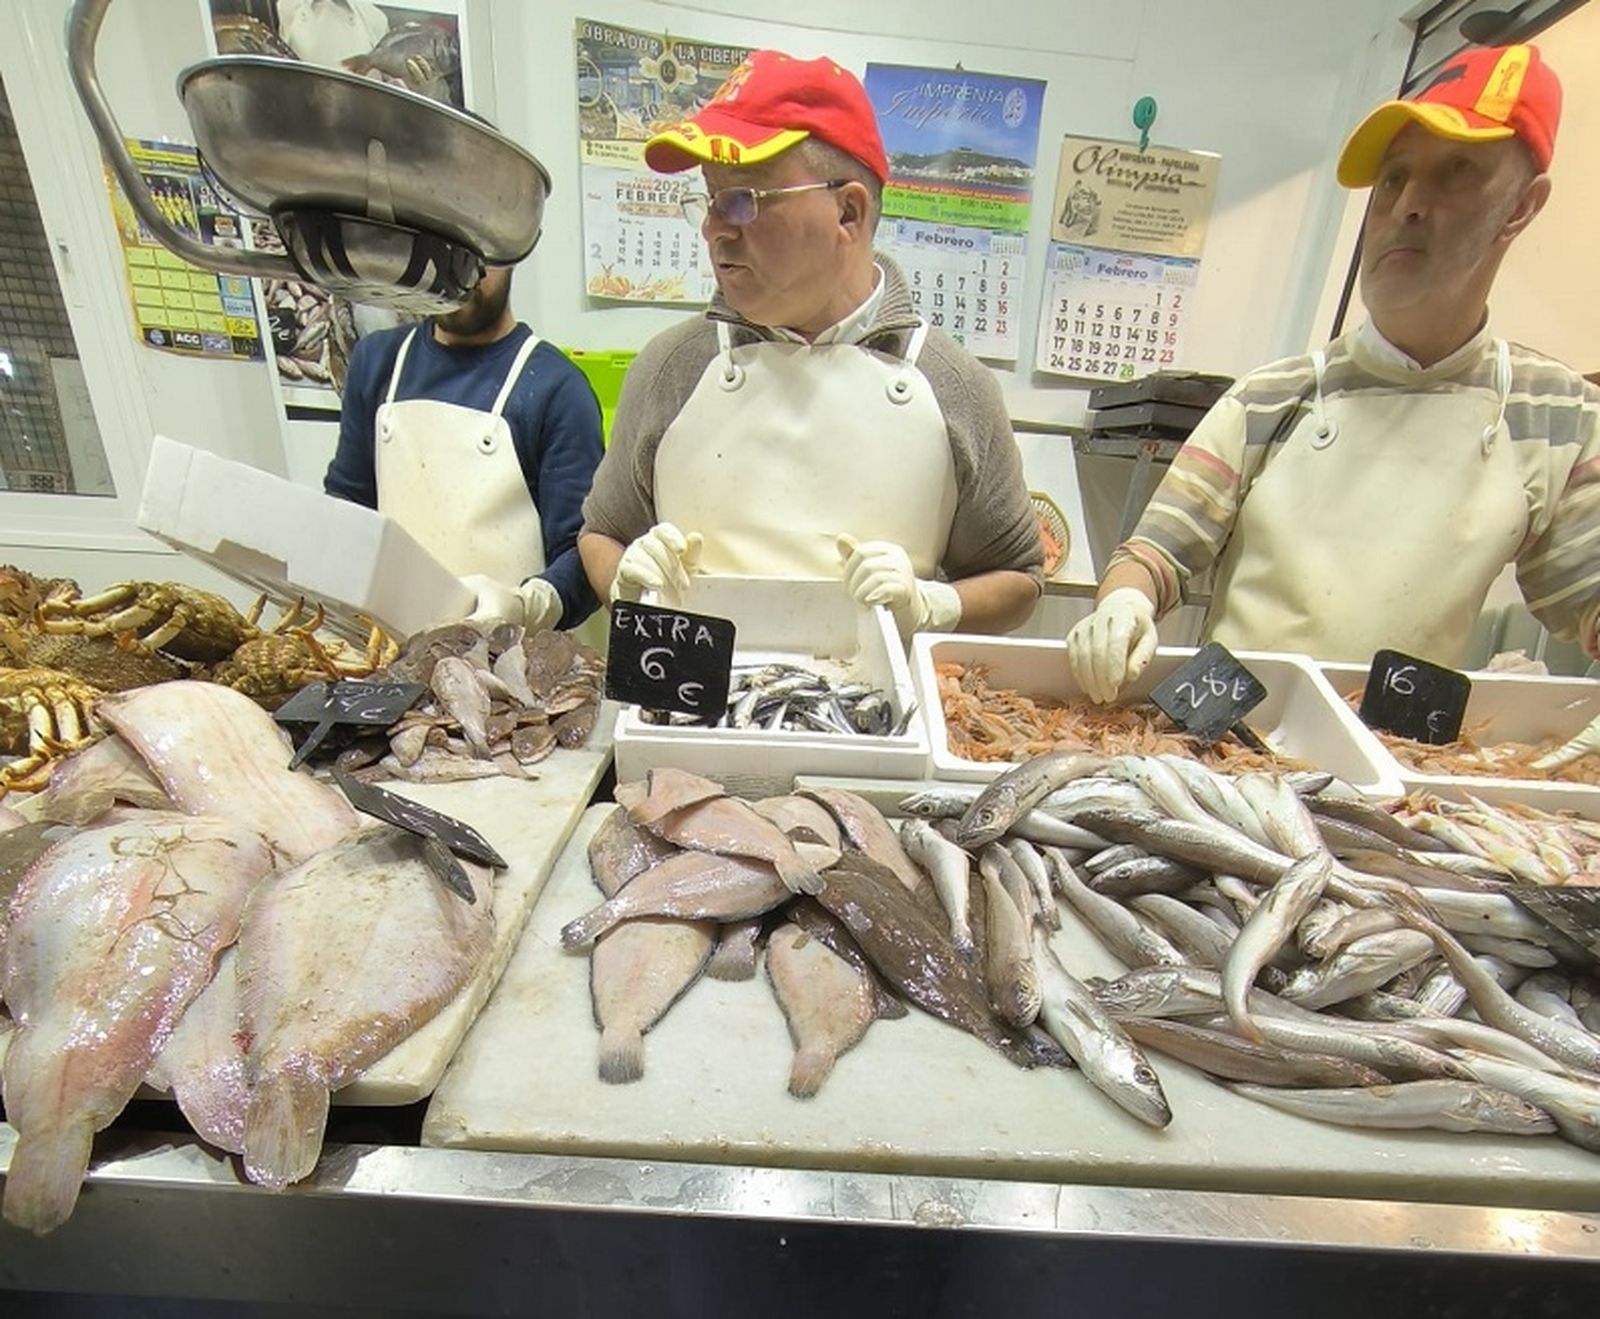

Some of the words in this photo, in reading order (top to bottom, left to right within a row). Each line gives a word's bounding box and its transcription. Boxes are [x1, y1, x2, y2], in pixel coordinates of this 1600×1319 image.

[582, 23, 660, 55] OBRADOR
[677, 44, 697, 61] LA
[700, 48, 748, 65] CIBELE
[920, 82, 1005, 103] IMPRENTA
[1073, 146, 1206, 191] Olimpia
[616, 188, 679, 204] FEBRER
[915, 231, 974, 249] Febrero
[982, 259, 987, 274] 1
[1002, 261, 1009, 276] 2
[1097, 263, 1148, 279] Febrero
[914, 271, 921, 285] 5
[936, 274, 944, 288] 6
[958, 277, 966, 290] 7
[978, 279, 987, 293] 8
[1000, 281, 1008, 295] 9
[912, 291, 922, 304] 12
[934, 293, 944, 307] 13
[955, 296, 966, 310] 14
[976, 298, 987, 312] 15
[998, 300, 1008, 314] 16
[1156, 293, 1162, 306] 1
[1172, 295, 1182, 308] 2
[932, 312, 944, 326] 20
[954, 315, 964, 328] 21
[974, 318, 988, 332] 22
[996, 320, 1006, 334] 23
[1060, 299, 1068, 313] 3
[1078, 303, 1087, 316] 4
[1096, 305, 1104, 318] 5
[1114, 307, 1122, 320] 6
[1132, 309, 1142, 323] 7
[1151, 311, 1160, 325] 8
[1169, 313, 1178, 327] 9
[1056, 318, 1068, 332] 10
[1074, 320, 1085, 335] 11
[1092, 323, 1104, 337] 12
[1110, 325, 1121, 339] 13
[1127, 328, 1140, 342] 14
[1146, 330, 1158, 344] 15
[1164, 332, 1176, 346] 16
[1054, 336, 1066, 350] 17
[1071, 339, 1084, 353] 18
[1089, 341, 1101, 356] 19
[1106, 343, 1120, 358] 20
[1124, 346, 1136, 360] 21
[1142, 348, 1156, 362] 22
[1159, 350, 1174, 364] 23
[1050, 354, 1064, 368] 24
[1068, 357, 1082, 371] 25
[1085, 359, 1100, 373] 26
[1103, 361, 1118, 375] 27
[1120, 363, 1135, 378] 28
[614, 608, 715, 648] EXTRA
[640, 647, 675, 680] 6
[1382, 665, 1417, 695] 16
[678, 682, 705, 706] €
[1427, 709, 1449, 733] €
